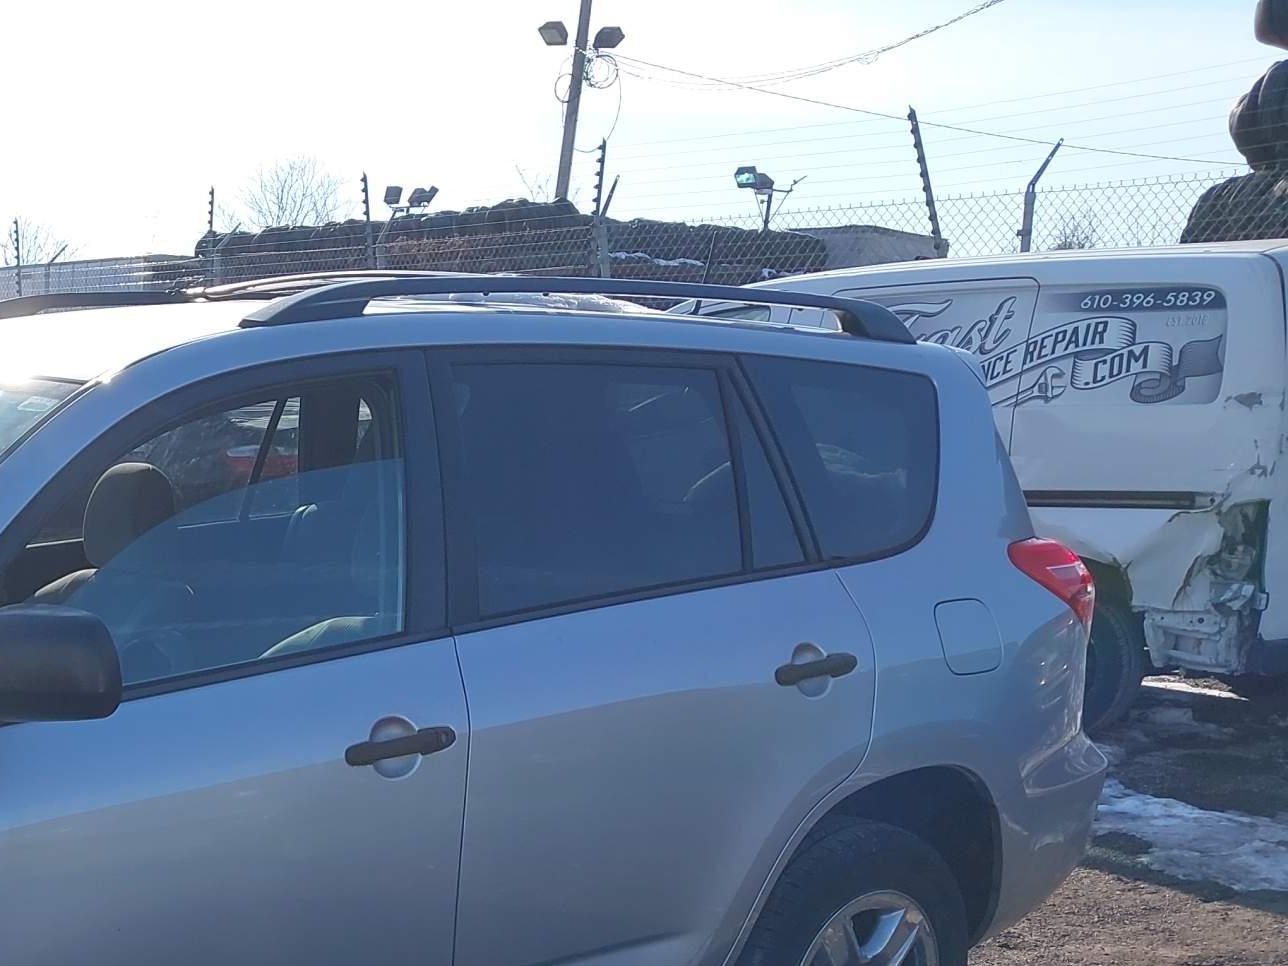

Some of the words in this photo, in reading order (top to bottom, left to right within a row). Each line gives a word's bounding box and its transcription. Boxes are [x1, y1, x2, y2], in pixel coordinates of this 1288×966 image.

[1079, 290, 1216, 310] 610-396-5839
[1023, 319, 1110, 366] REPAIR
[1083, 344, 1151, 387] .COM
